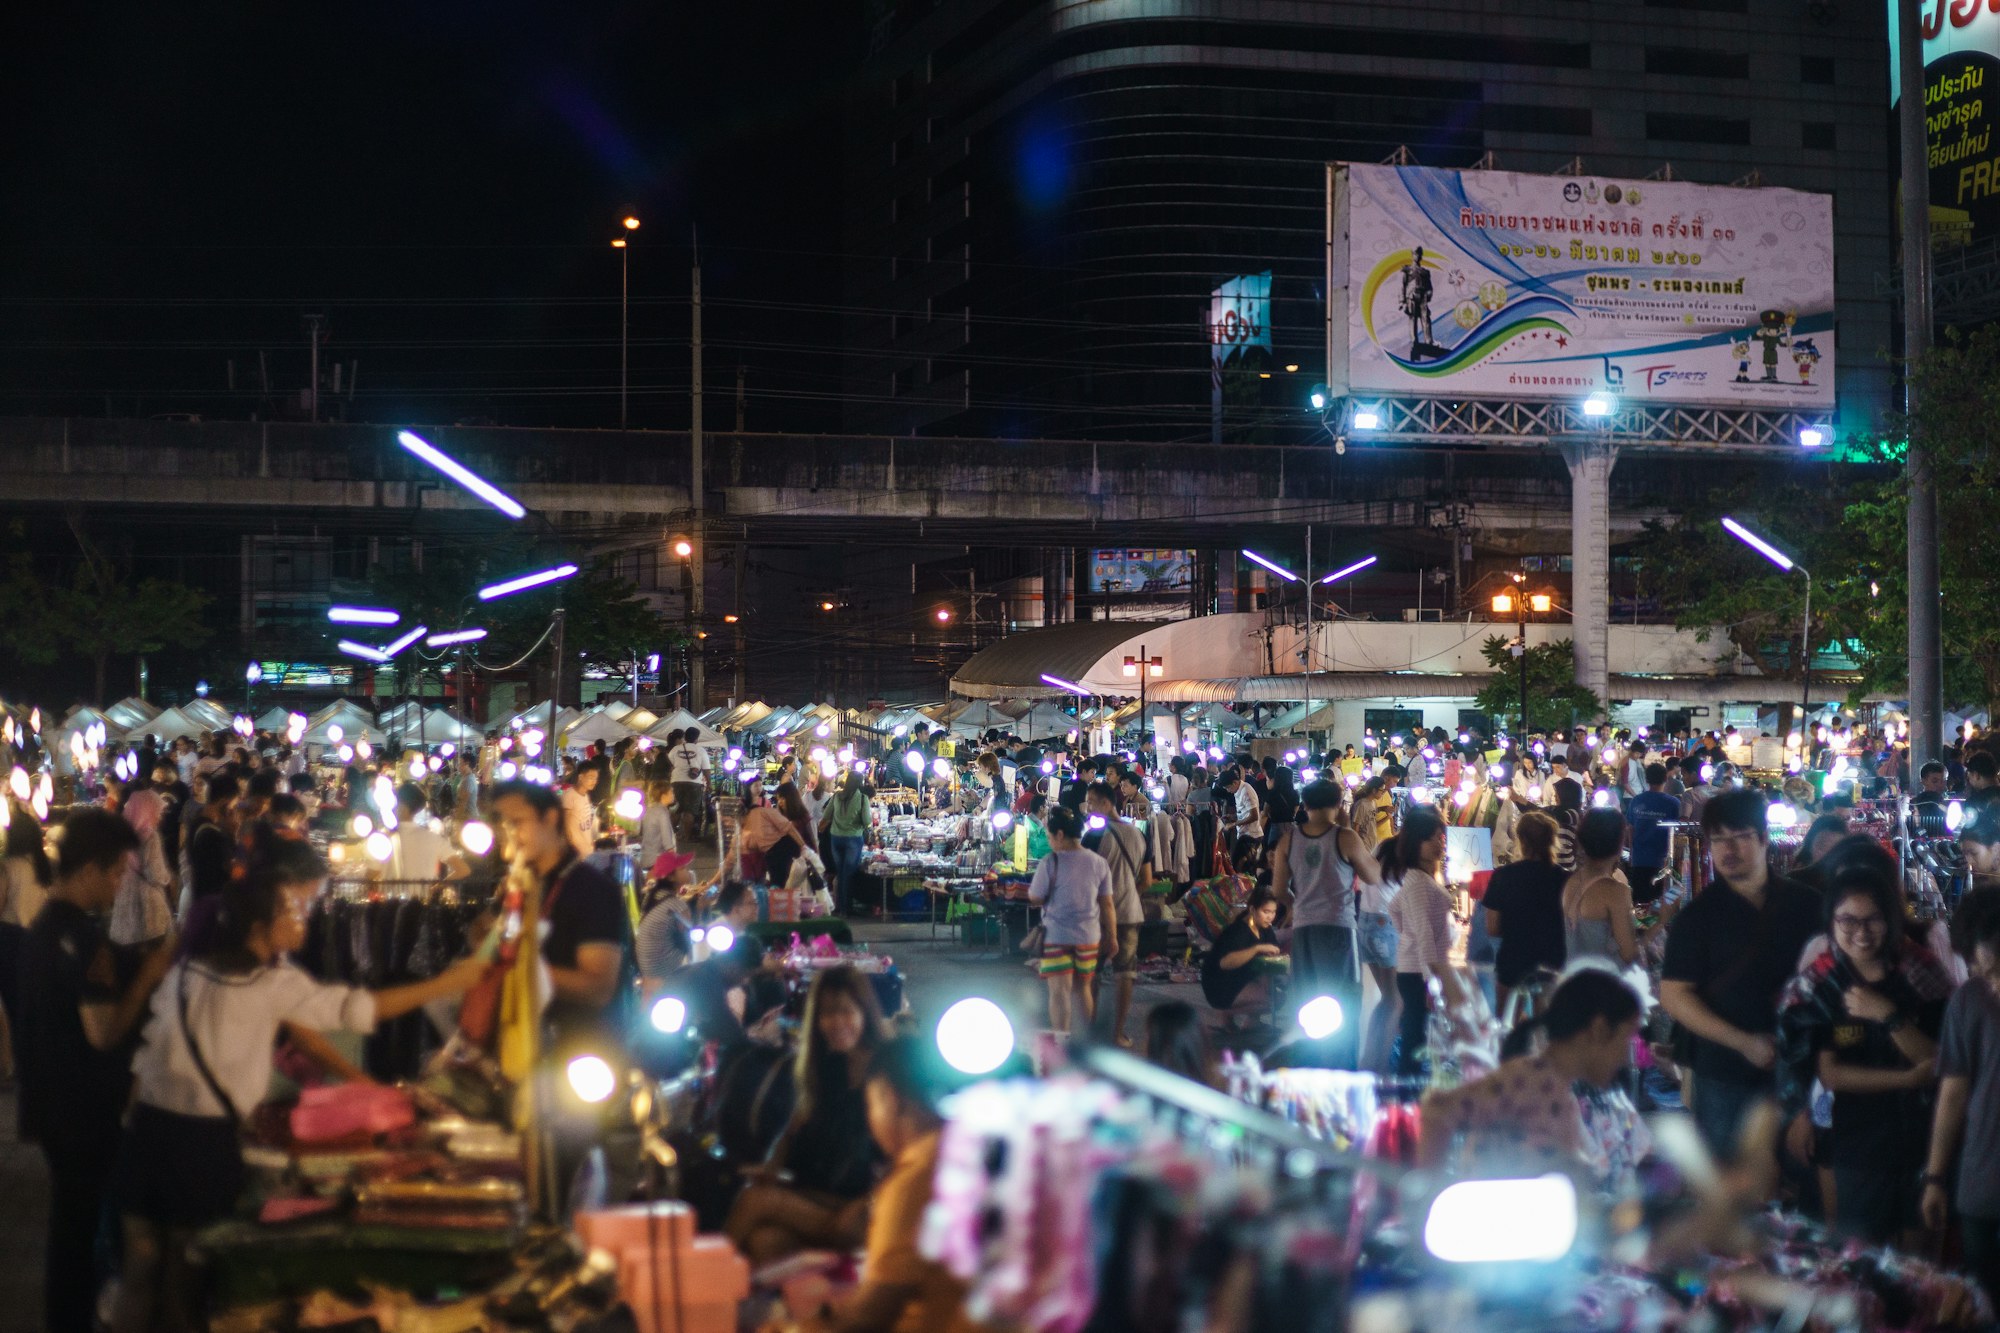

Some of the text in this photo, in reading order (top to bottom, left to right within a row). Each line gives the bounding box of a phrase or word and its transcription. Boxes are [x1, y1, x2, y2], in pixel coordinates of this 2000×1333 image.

[1926, 123, 1990, 168] ลี่ยนใหม่
[1652, 214, 1705, 239] ครั้งที่
[1570, 239, 1640, 263] มีนาคม
[1586, 275, 1631, 293] ชุมพร
